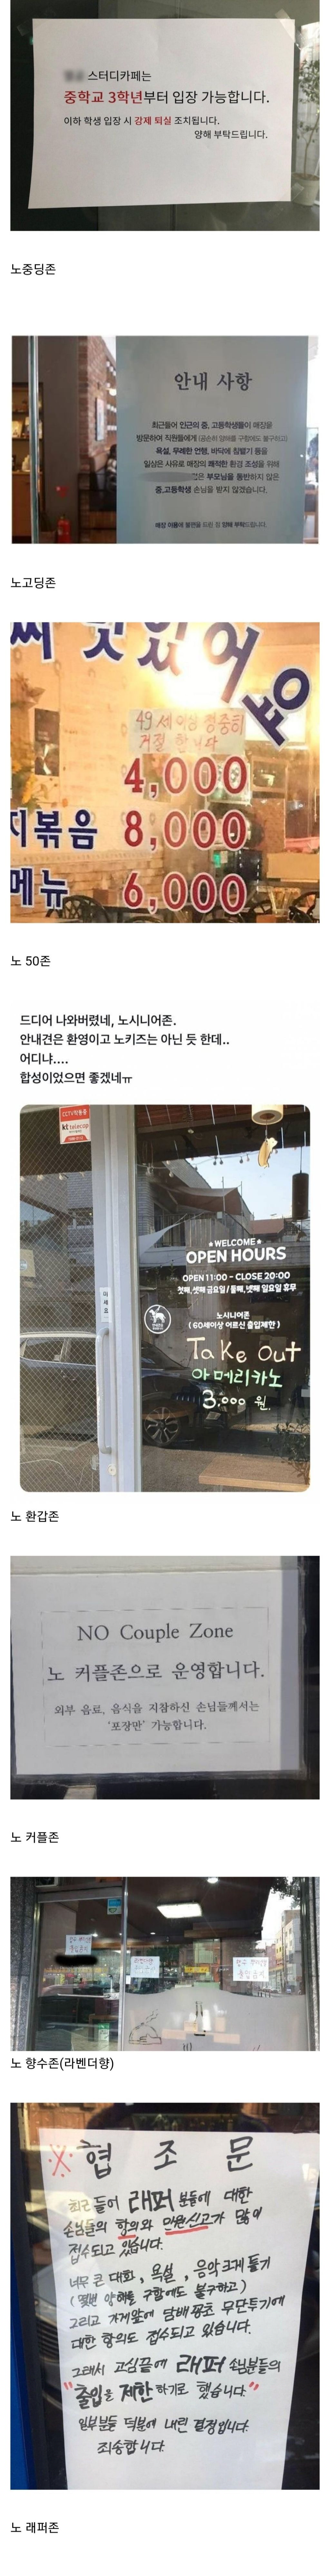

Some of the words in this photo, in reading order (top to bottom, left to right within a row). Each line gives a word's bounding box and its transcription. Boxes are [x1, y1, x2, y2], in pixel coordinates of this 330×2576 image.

[88, 71, 151, 81] 스터디카페는
[64, 91, 104, 104] 중학교
[109, 91, 167, 104] 3학년부터
[173, 91, 197, 103] 입장
[202, 91, 269, 103] 가능합니다.
[64, 117, 81, 125] 이하
[84, 117, 101, 125] 학생
[104, 117, 121, 125] 입장
[124, 117, 131, 125] 시
[135, 116, 151, 125] 강제
[155, 116, 171, 125] 퇴실
[175, 116, 219, 125] 조치됩니다.
[195, 130, 210, 139] 양해
[214, 130, 267, 139] 부탁드립니다.
[175, 372, 207, 391] 안내
[217, 372, 252, 391] 사항
[124, 756, 247, 798] 4,000
[124, 810, 247, 850] 8,000
[10, 868, 68, 907] 메뉴
[124, 872, 246, 913] 6,000
[215, 1238, 256, 1247] WELCOME
[186, 1250, 227, 1264] OPEN
[231, 1247, 286, 1262] HOURS
[261, 1284, 281, 1292] 일요일
[283, 1283, 296, 1292] 휴무
[217, 1311, 250, 1319] 노시니어존
[192, 1368, 283, 1388] 아메리카노
[77, 1625, 109, 1640] NO
[121, 1623, 179, 1643] Couple
[190, 1623, 233, 1638] Zone
[48, 1667, 64, 1680] 노
[76, 1664, 162, 1682] 커플존으로
[172, 1661, 264, 1679] 운영합니다.
[55, 1705, 75, 1716] 외부
[81, 1705, 104, 1715] 음료,
[111, 1703, 142, 1714] 음식을
[150, 1702, 189, 1713] 지참하신
[196, 1701, 259, 1712] 손님들께서는
[152, 1719, 206, 1731] 가능합니다.
[129, 2188, 174, 2214] 래퍼
[224, 2186, 253, 2204] 대한
[63, 2218, 107, 2238] 손님들의
[115, 2218, 154, 2236] 항의와
[236, 2207, 262, 2225] 많이
[68, 2243, 115, 2265] 접수되고
[70, 2276, 89, 2289] 너무
[69, 2315, 101, 2329] 그리고
[71, 2335, 97, 2350] 대한
[101, 2332, 139, 2348] 항의도
[146, 2325, 195, 2346] 접수되고
[177, 2354, 227, 2375] 래퍼
